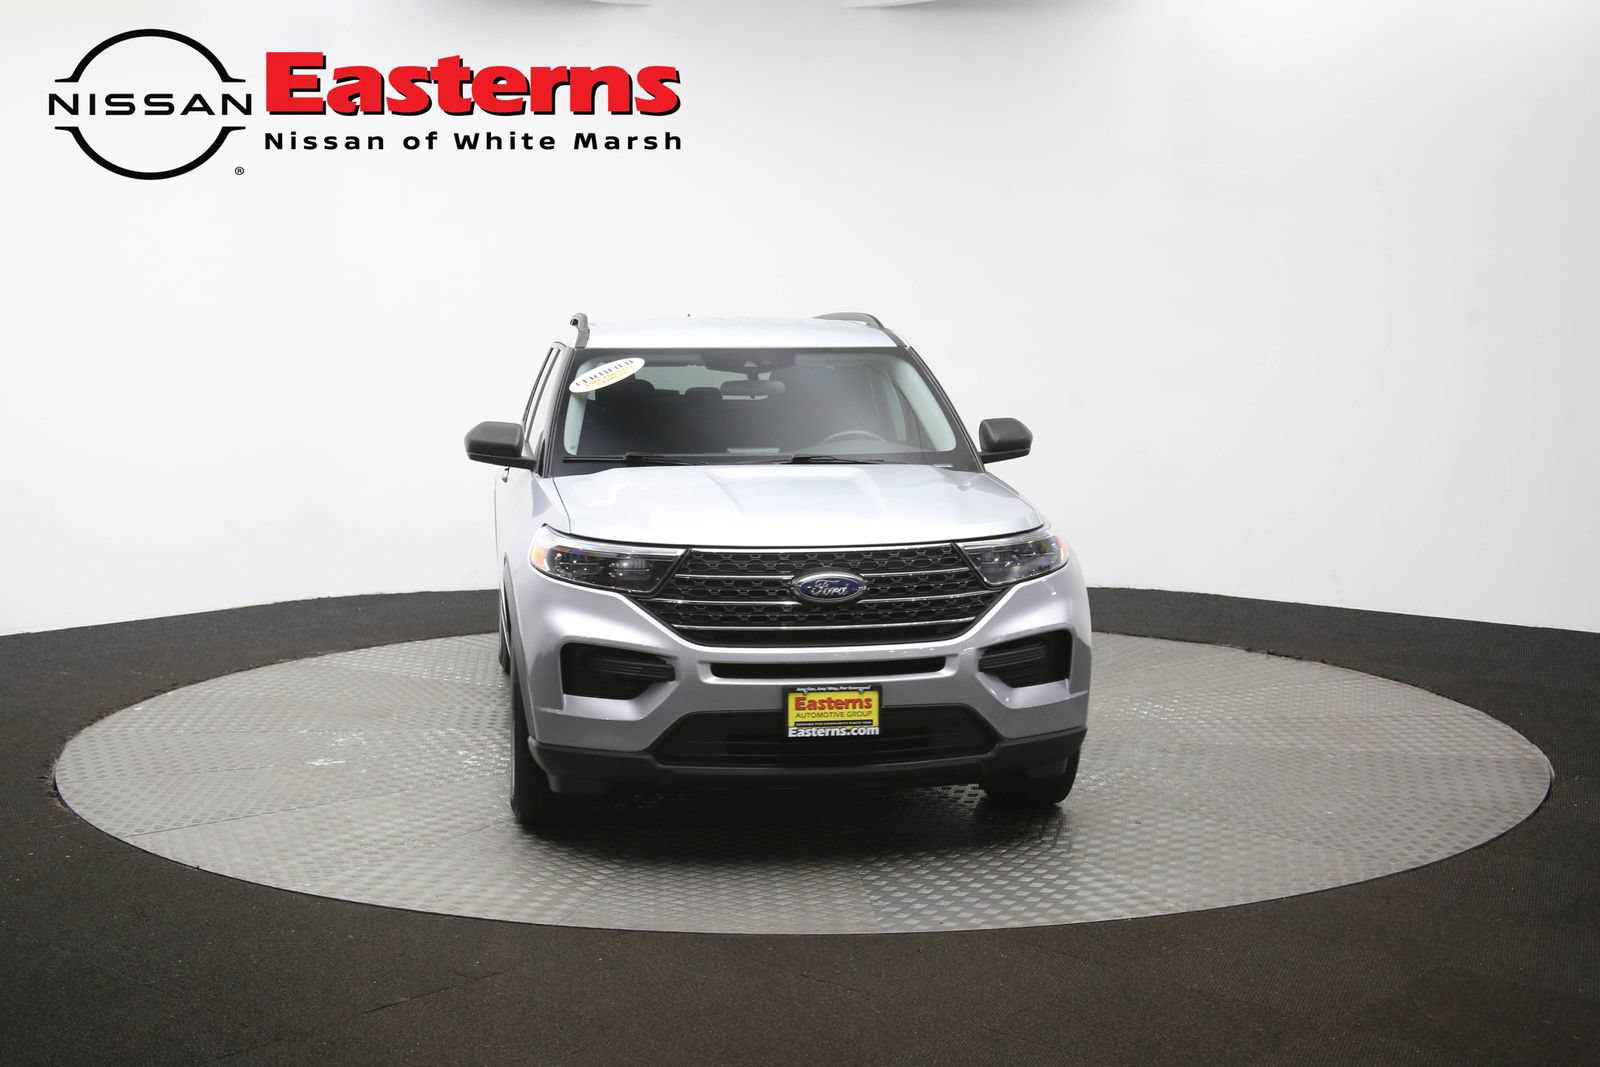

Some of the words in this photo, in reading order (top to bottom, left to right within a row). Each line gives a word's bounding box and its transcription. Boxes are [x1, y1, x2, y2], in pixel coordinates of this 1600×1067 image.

[811, 579, 850, 596] Ford
[795, 697, 872, 711] Easterns
[788, 727, 879, 737] Easterns.com
